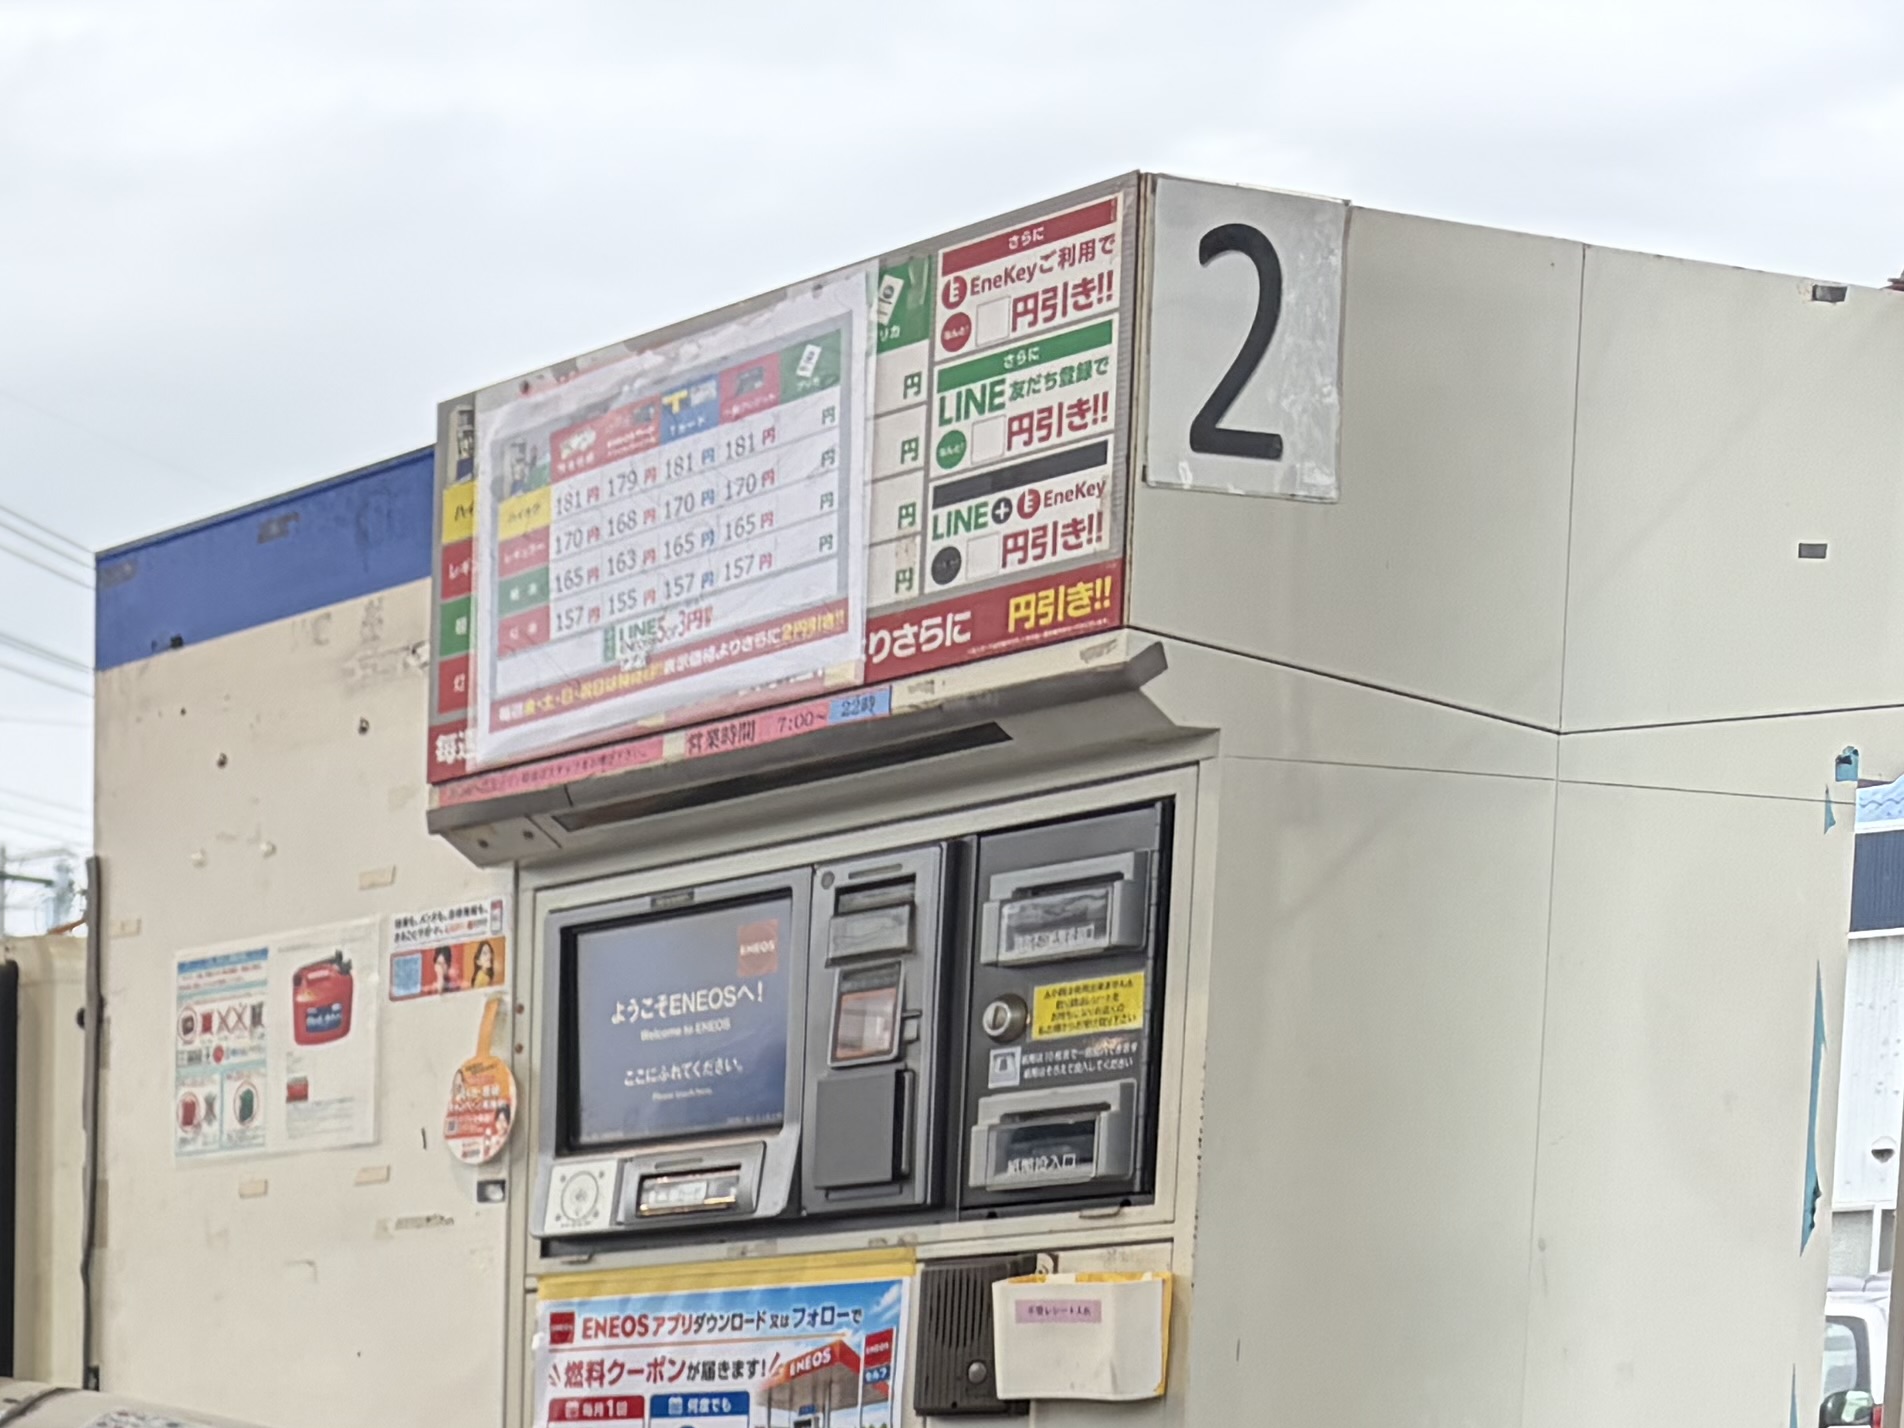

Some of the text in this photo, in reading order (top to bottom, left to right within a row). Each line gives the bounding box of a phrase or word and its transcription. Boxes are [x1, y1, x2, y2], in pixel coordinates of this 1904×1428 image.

[1008, 226, 1045, 250] さらに
[1011, 270, 1114, 333] 円引き!!
[1003, 346, 1040, 369] さらに
[1189, 222, 1283, 460] 2
[903, 371, 922, 400] 円
[938, 378, 1006, 427] LINE
[1007, 390, 1109, 452] 円引き!!
[666, 452, 693, 479] 181
[726, 432, 755, 460] 181
[900, 436, 919, 465] 円
[664, 493, 693, 519] 170
[726, 474, 757, 501] 170
[898, 502, 916, 530] 円
[931, 480, 1107, 541] LINE EneKey
[664, 532, 694, 559] 165
[724, 514, 756, 542] 165
[1001, 511, 1103, 569] 円引き!!
[664, 569, 694, 596] 157
[724, 553, 755, 581] 157
[895, 567, 913, 594] 円
[1008, 575, 1113, 633] 円引き!!
[610, 980, 764, 1025] ようこそENEOSへ!
[582, 1314, 649, 1339] ENEOS
[652, 1310, 766, 1337] アプリダウンロード
[790, 1347, 832, 1377] ENEOS
